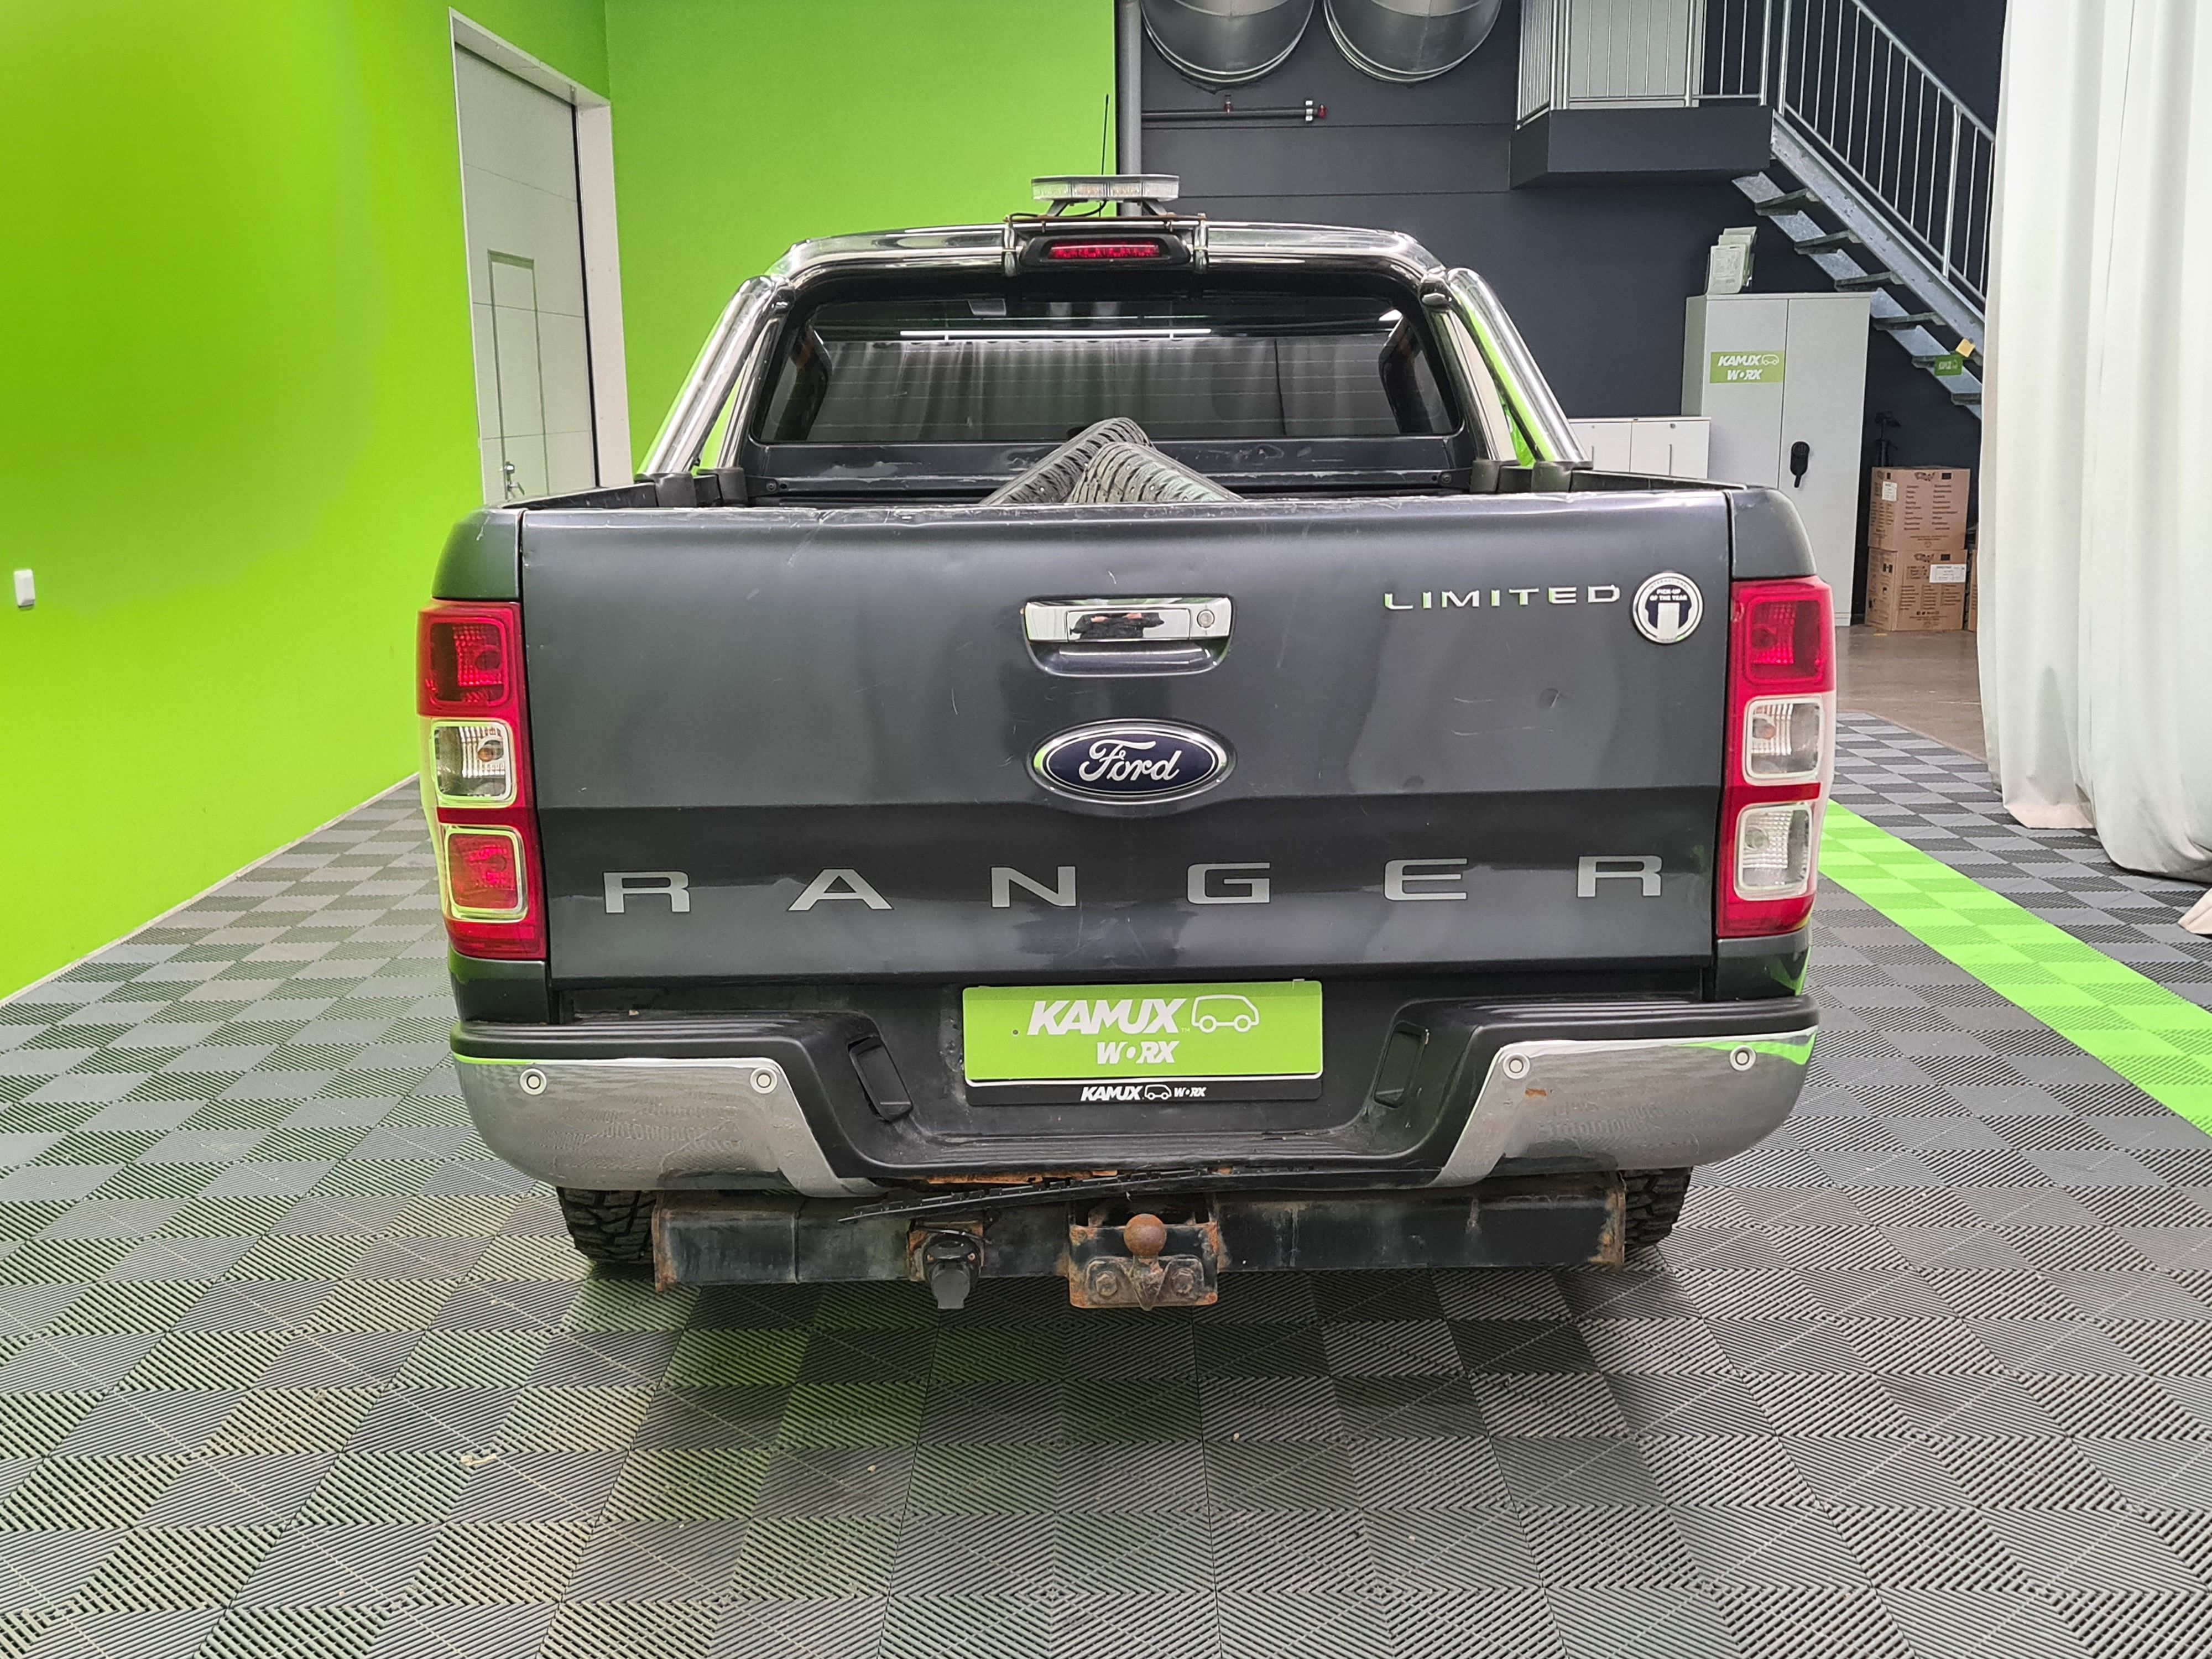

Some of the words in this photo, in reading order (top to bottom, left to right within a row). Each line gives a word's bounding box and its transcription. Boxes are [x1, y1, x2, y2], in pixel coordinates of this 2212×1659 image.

[1718, 355, 1762, 367] KAMUX
[1384, 585, 1620, 609] LIMITED
[1079, 739, 1182, 781] Ford
[602, 855, 1663, 914] RANGER
[1027, 998, 1187, 1035] KAMUX
[1081, 1086, 1143, 1101] KAMUX
